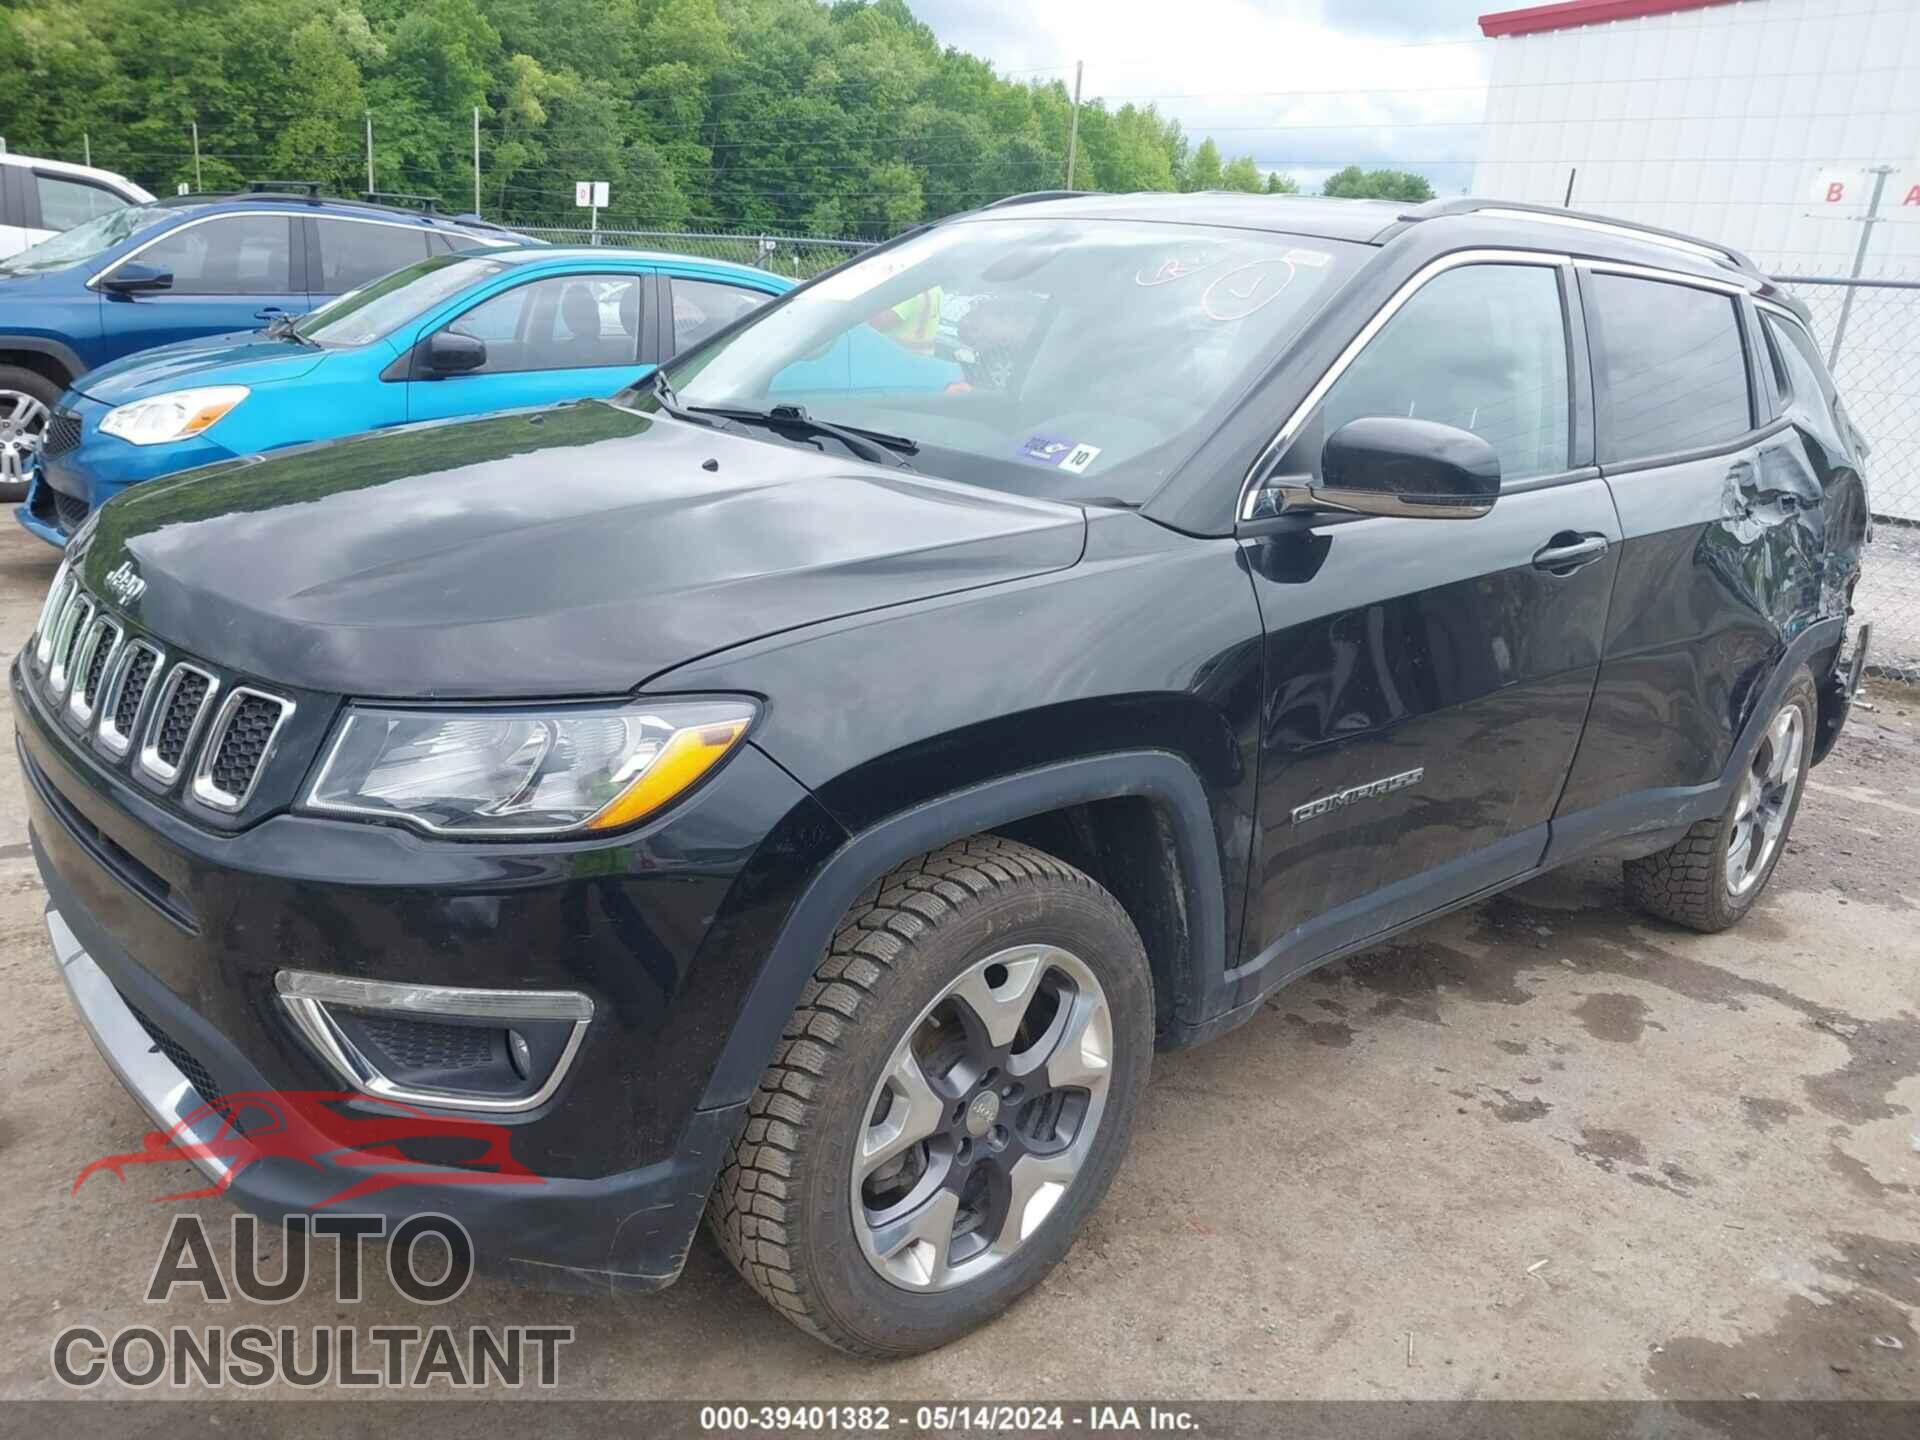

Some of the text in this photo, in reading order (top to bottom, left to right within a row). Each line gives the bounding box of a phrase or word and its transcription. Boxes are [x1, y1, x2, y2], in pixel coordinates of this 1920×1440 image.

[1825, 182, 1845, 203] B
[1903, 184, 1920, 206] A
[1071, 450, 1091, 466] 10
[104, 560, 147, 606] Jeep
[1292, 767, 1424, 824] COMPASS
